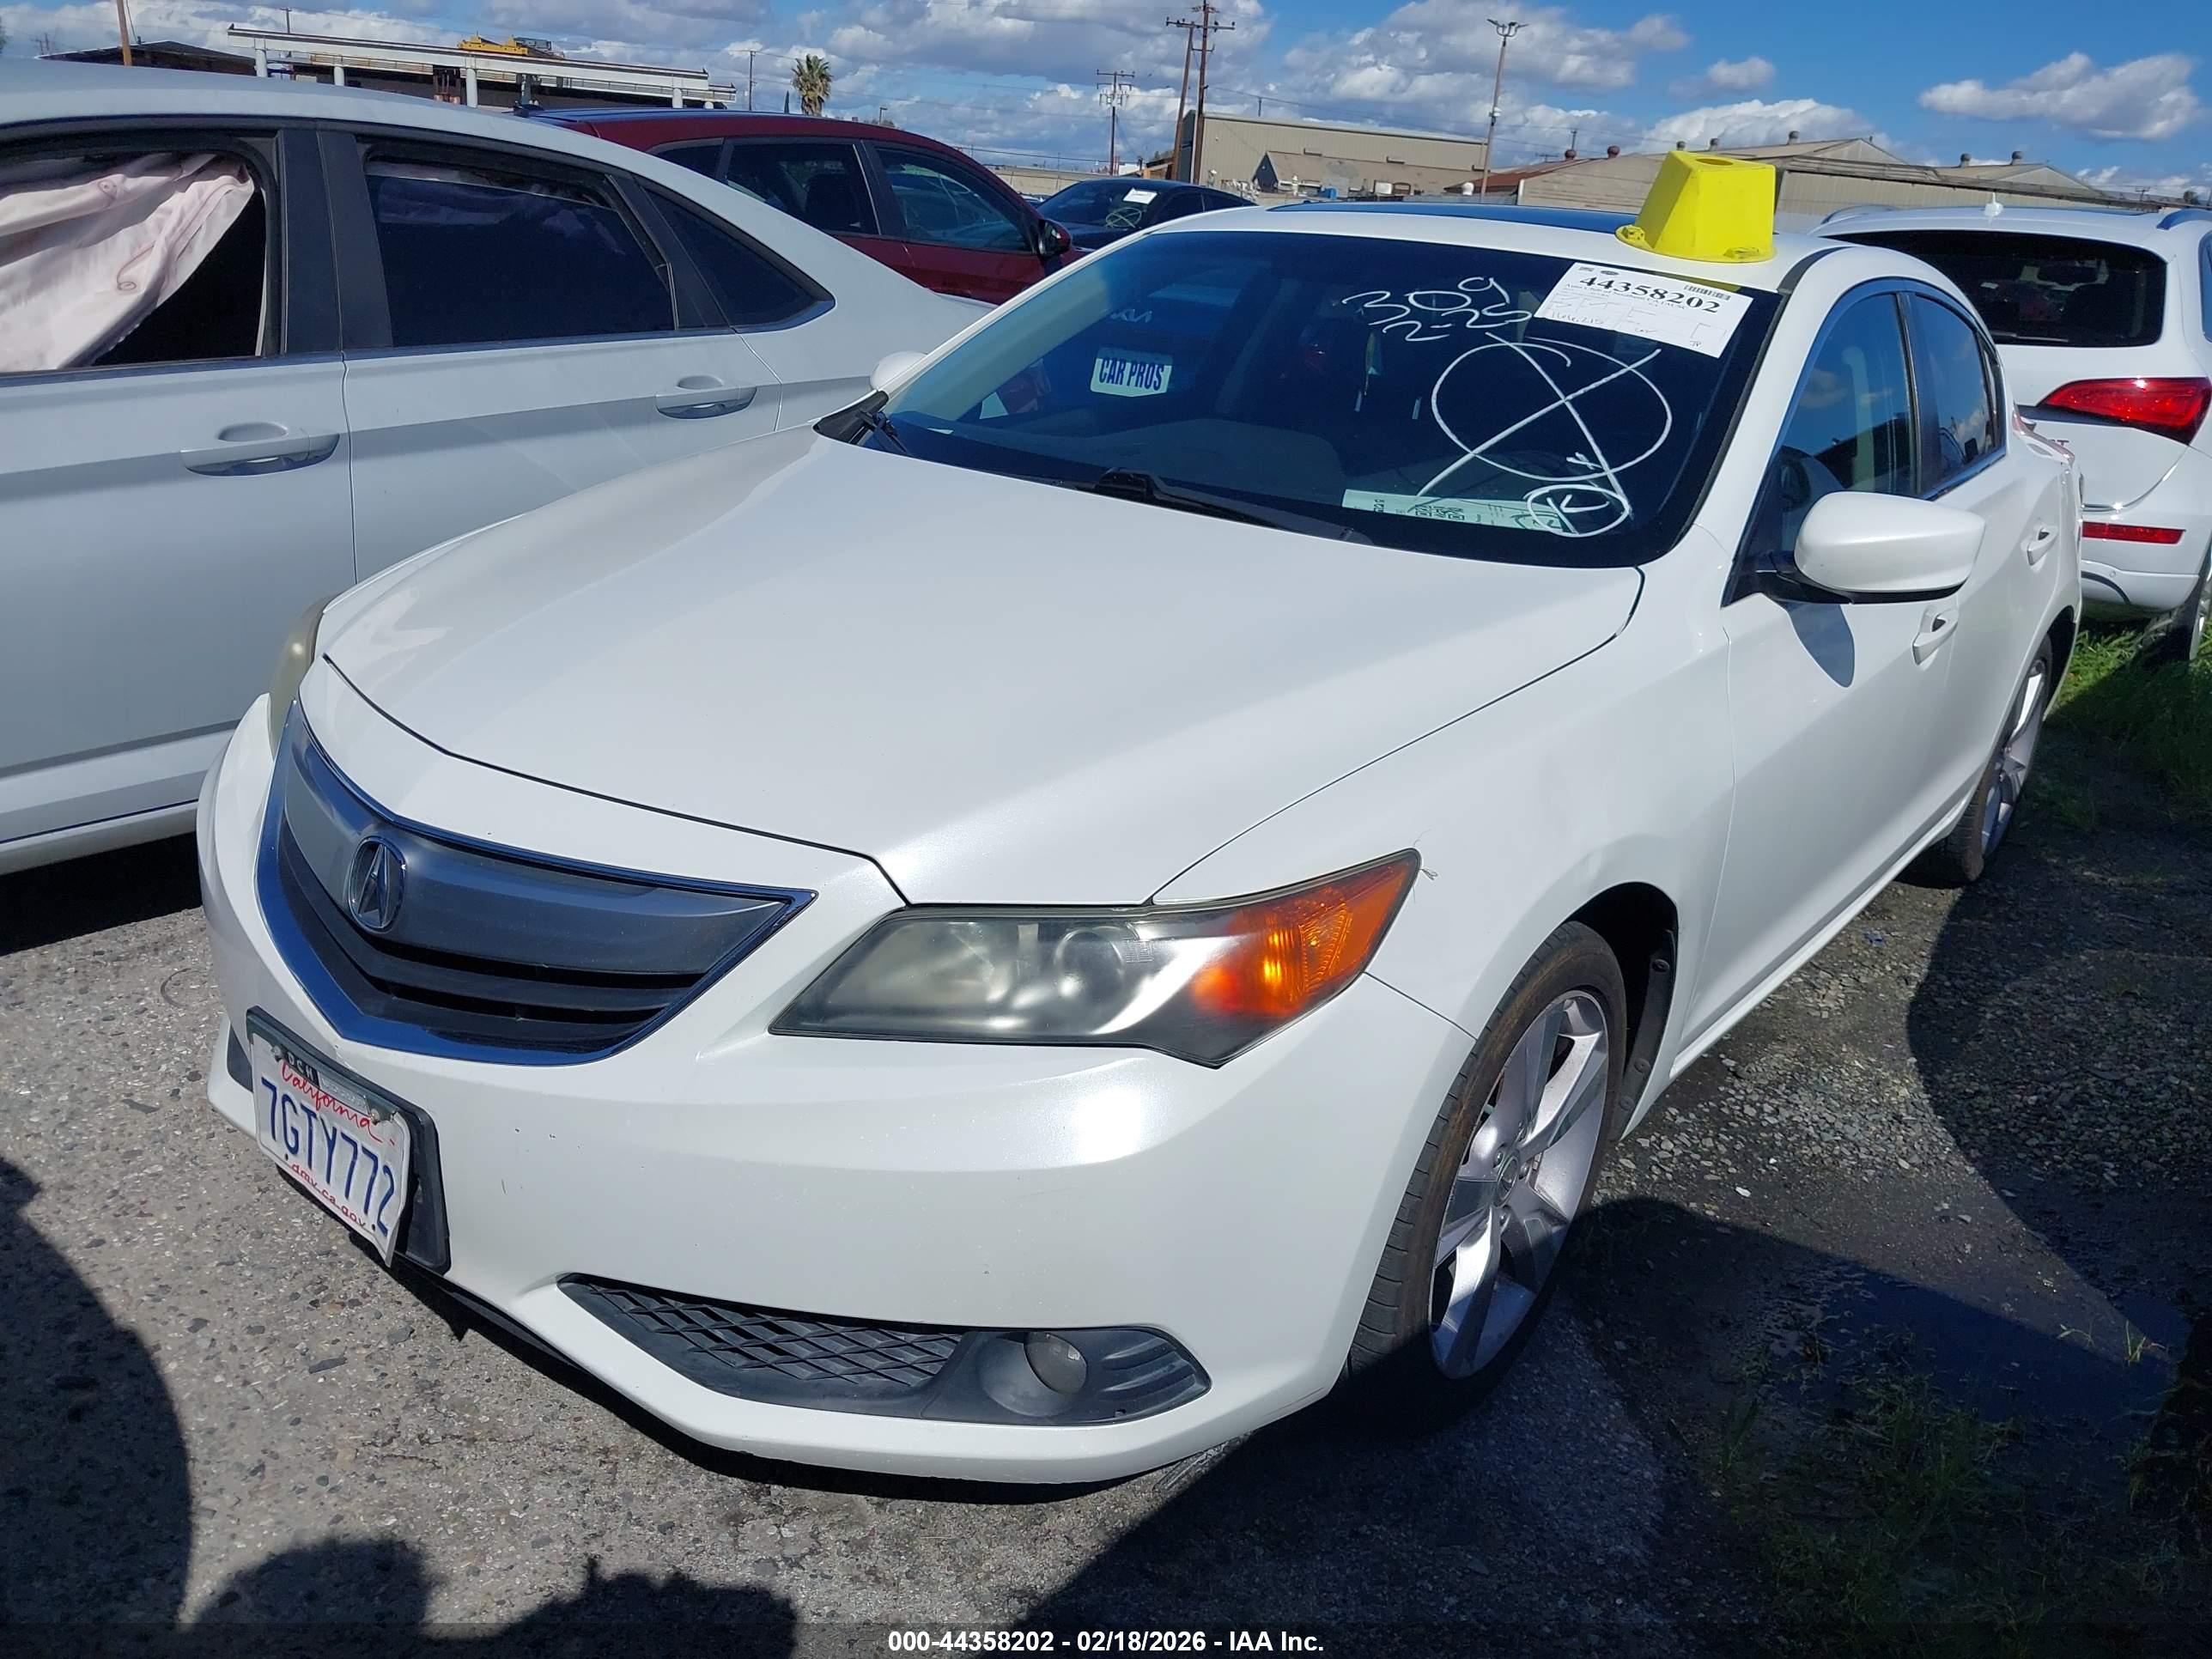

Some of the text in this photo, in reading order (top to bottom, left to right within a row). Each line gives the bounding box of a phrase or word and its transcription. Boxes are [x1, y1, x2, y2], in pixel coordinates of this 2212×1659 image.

[1578, 276, 1721, 313] 44358202
[1098, 358, 1165, 391] CAR PROS
[261, 1076, 395, 1237] 7GTY772
